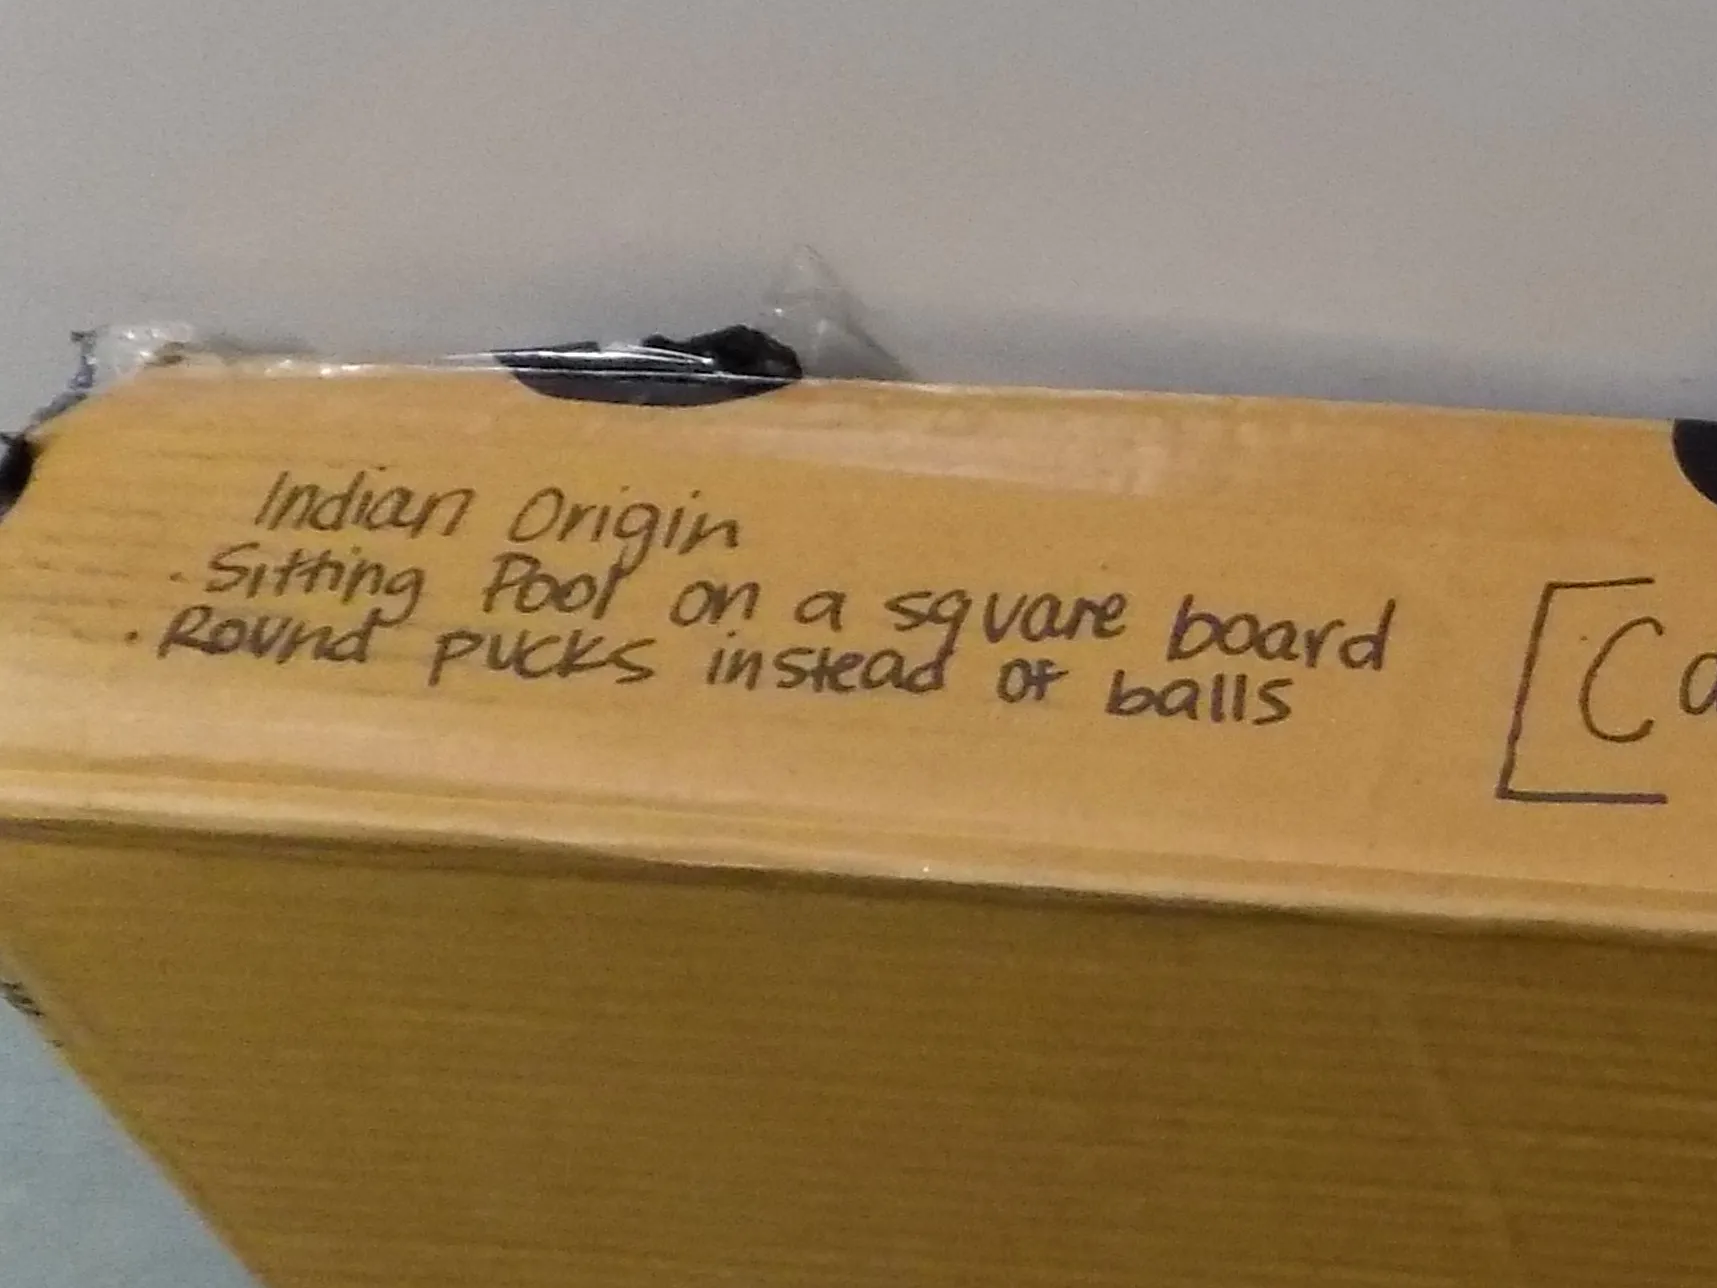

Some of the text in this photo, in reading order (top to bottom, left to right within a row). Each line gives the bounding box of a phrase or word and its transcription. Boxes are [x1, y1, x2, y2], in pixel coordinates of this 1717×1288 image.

[253, 468, 743, 569] Indian Origin
[155, 604, 388, 666] Round
[706, 624, 950, 696] instead
[997, 657, 1068, 706] of
[1104, 666, 1296, 727] balls
[203, 542, 1402, 680] Sitting Pool on a square board
